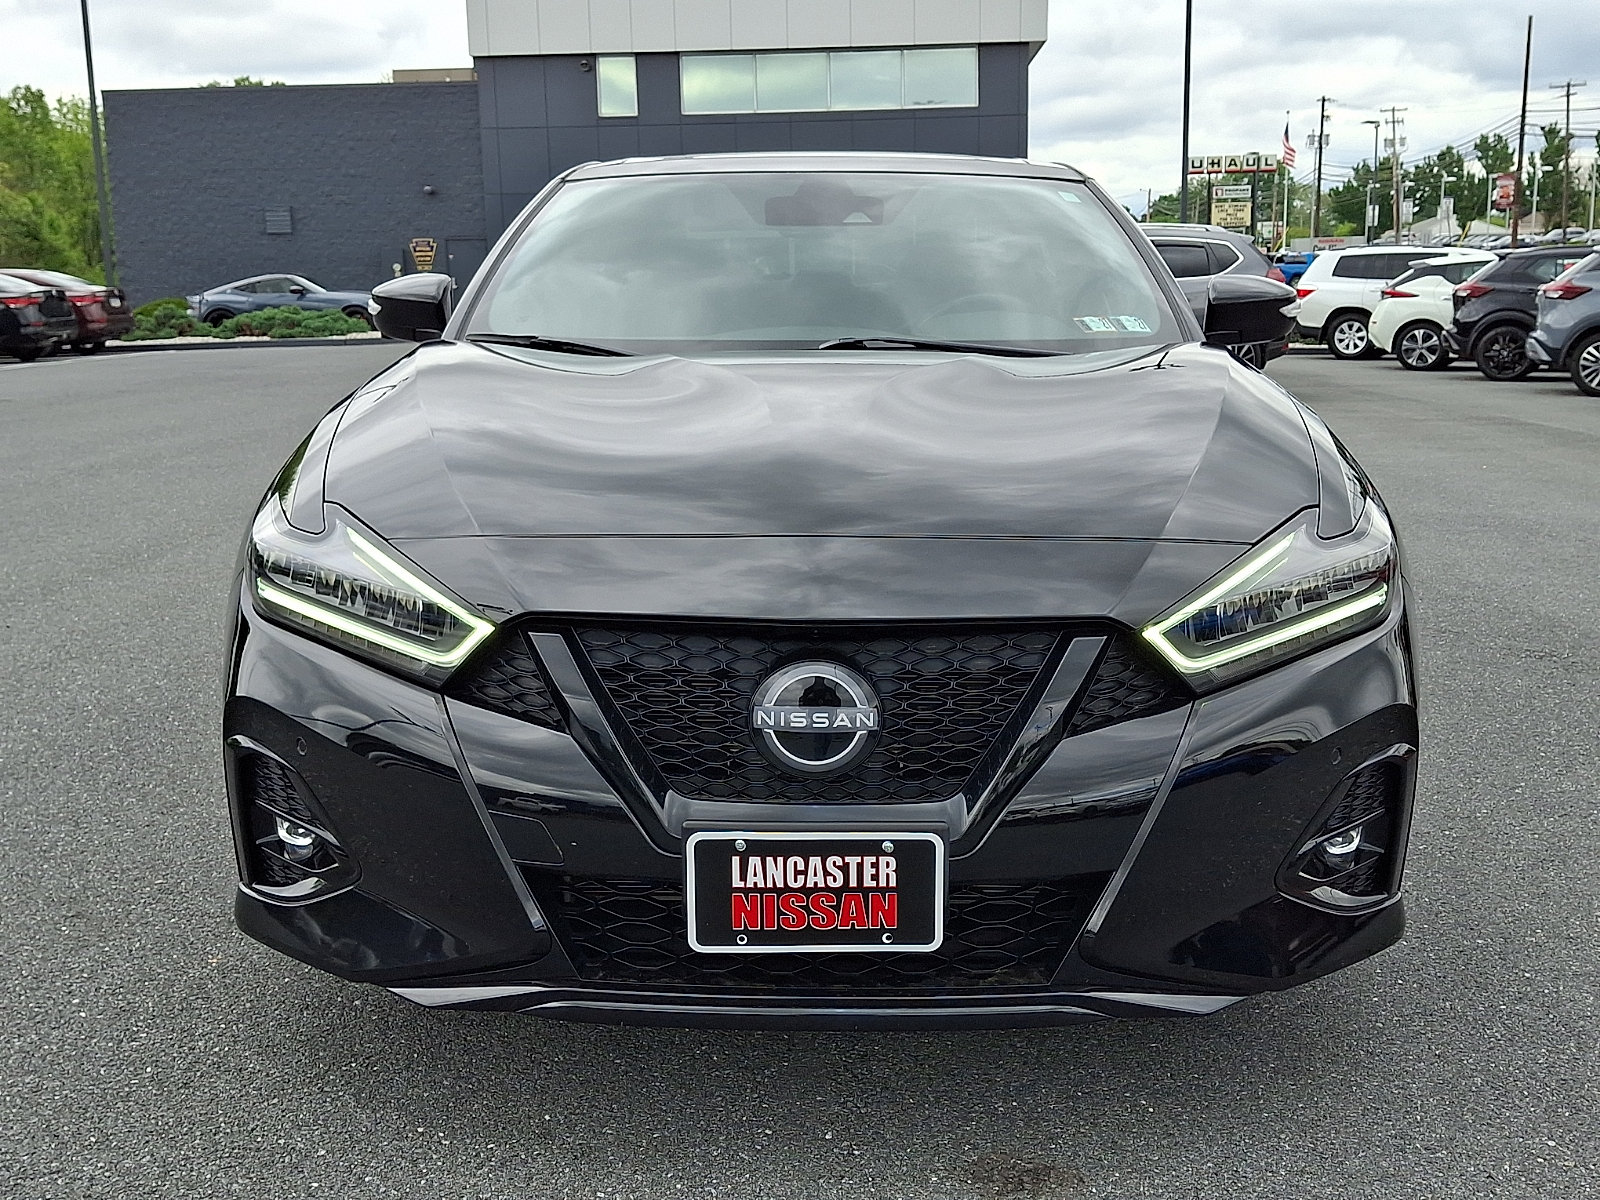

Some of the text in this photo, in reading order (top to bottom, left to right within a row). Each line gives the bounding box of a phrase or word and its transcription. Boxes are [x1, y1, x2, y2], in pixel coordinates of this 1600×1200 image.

[757, 710, 875, 728] NISSAN
[731, 856, 898, 888] LANCASTER
[731, 892, 899, 931] NISSAN
